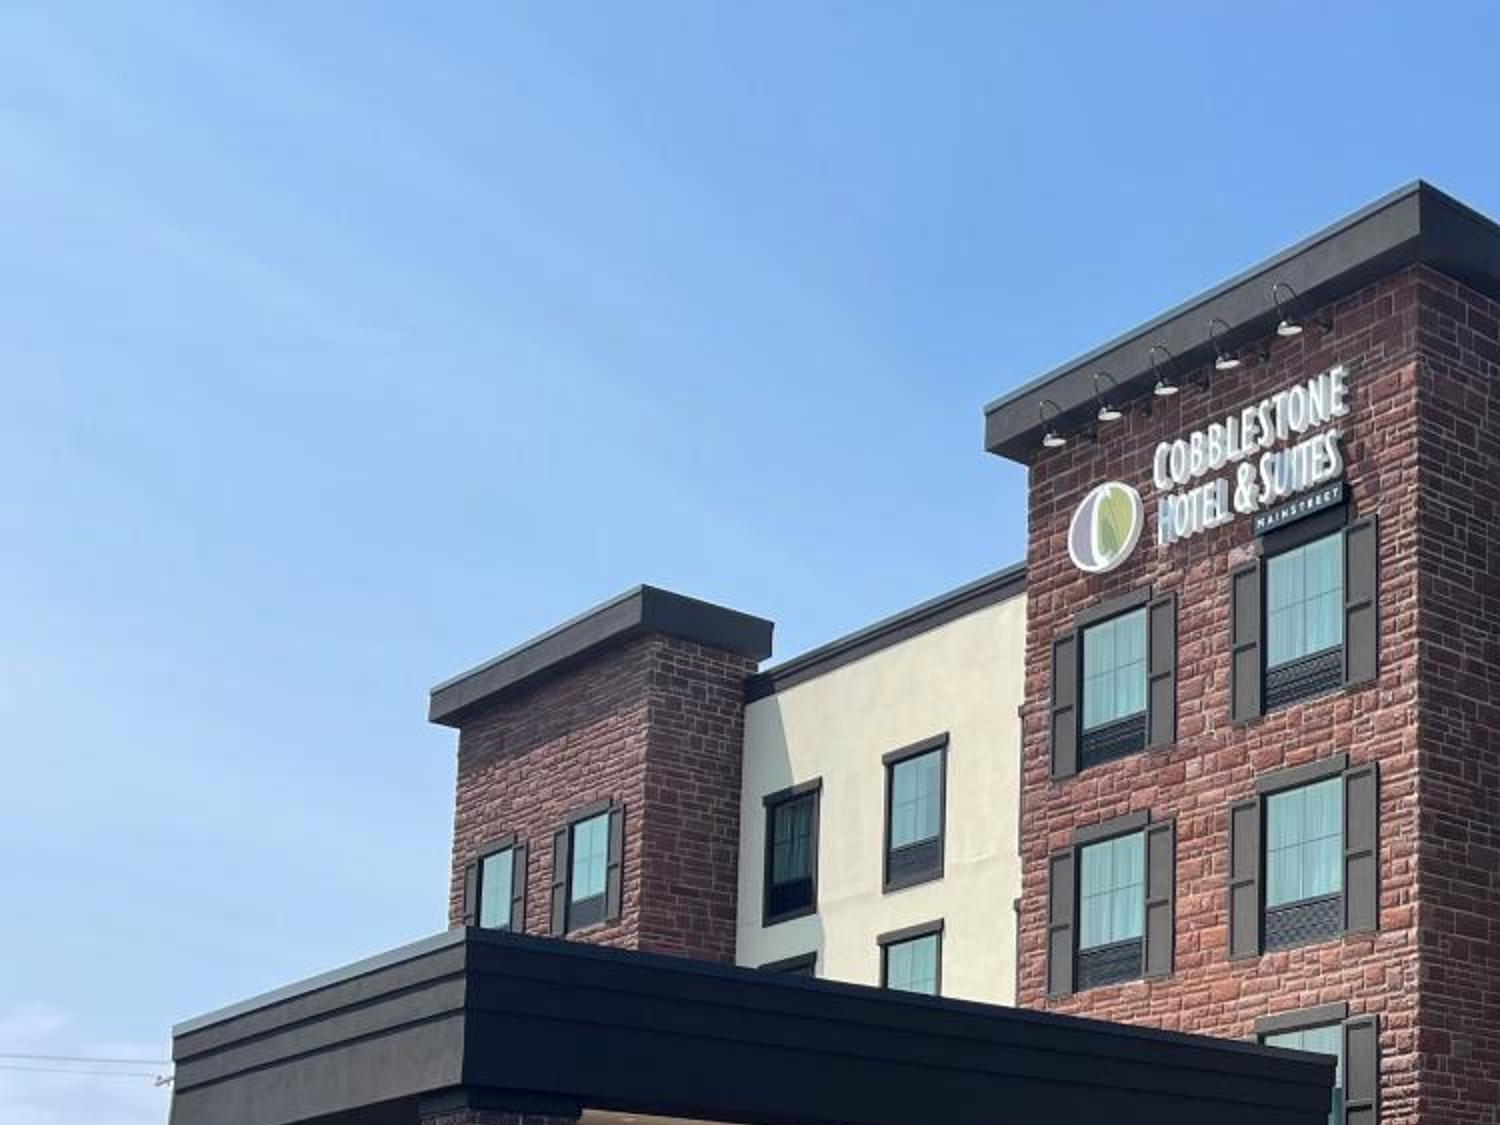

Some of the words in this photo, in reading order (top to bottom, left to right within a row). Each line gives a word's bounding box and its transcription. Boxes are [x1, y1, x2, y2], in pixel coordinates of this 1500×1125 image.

[1154, 366, 1349, 490] COBBLESTONE
[1158, 479, 1234, 545] HOTEL
[1235, 462, 1260, 513] &
[1259, 429, 1344, 504] SUITES
